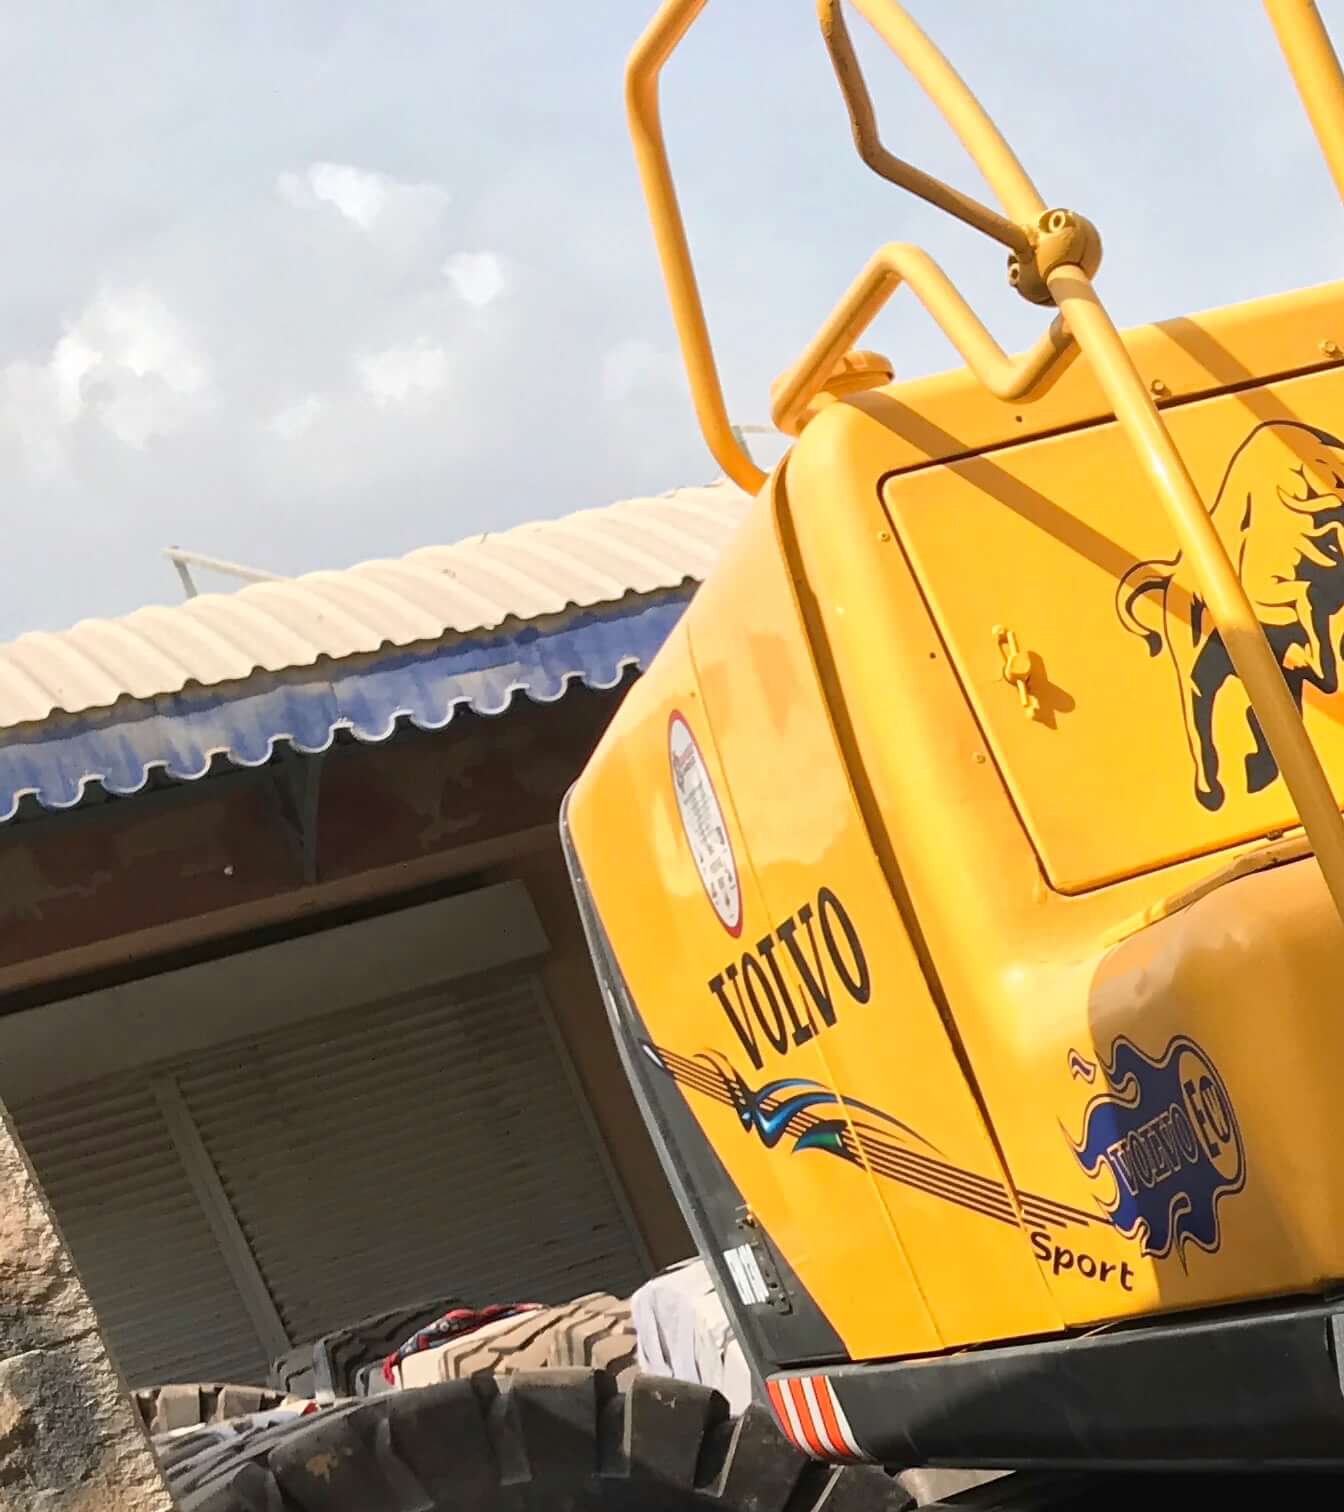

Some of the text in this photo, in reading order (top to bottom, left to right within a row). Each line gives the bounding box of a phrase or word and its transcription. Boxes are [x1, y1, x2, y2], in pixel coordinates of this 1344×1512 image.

[710, 886, 870, 1070] VOLVO
[1106, 1103, 1200, 1196] VOLVO
[1030, 1232, 1135, 1292] Sport
